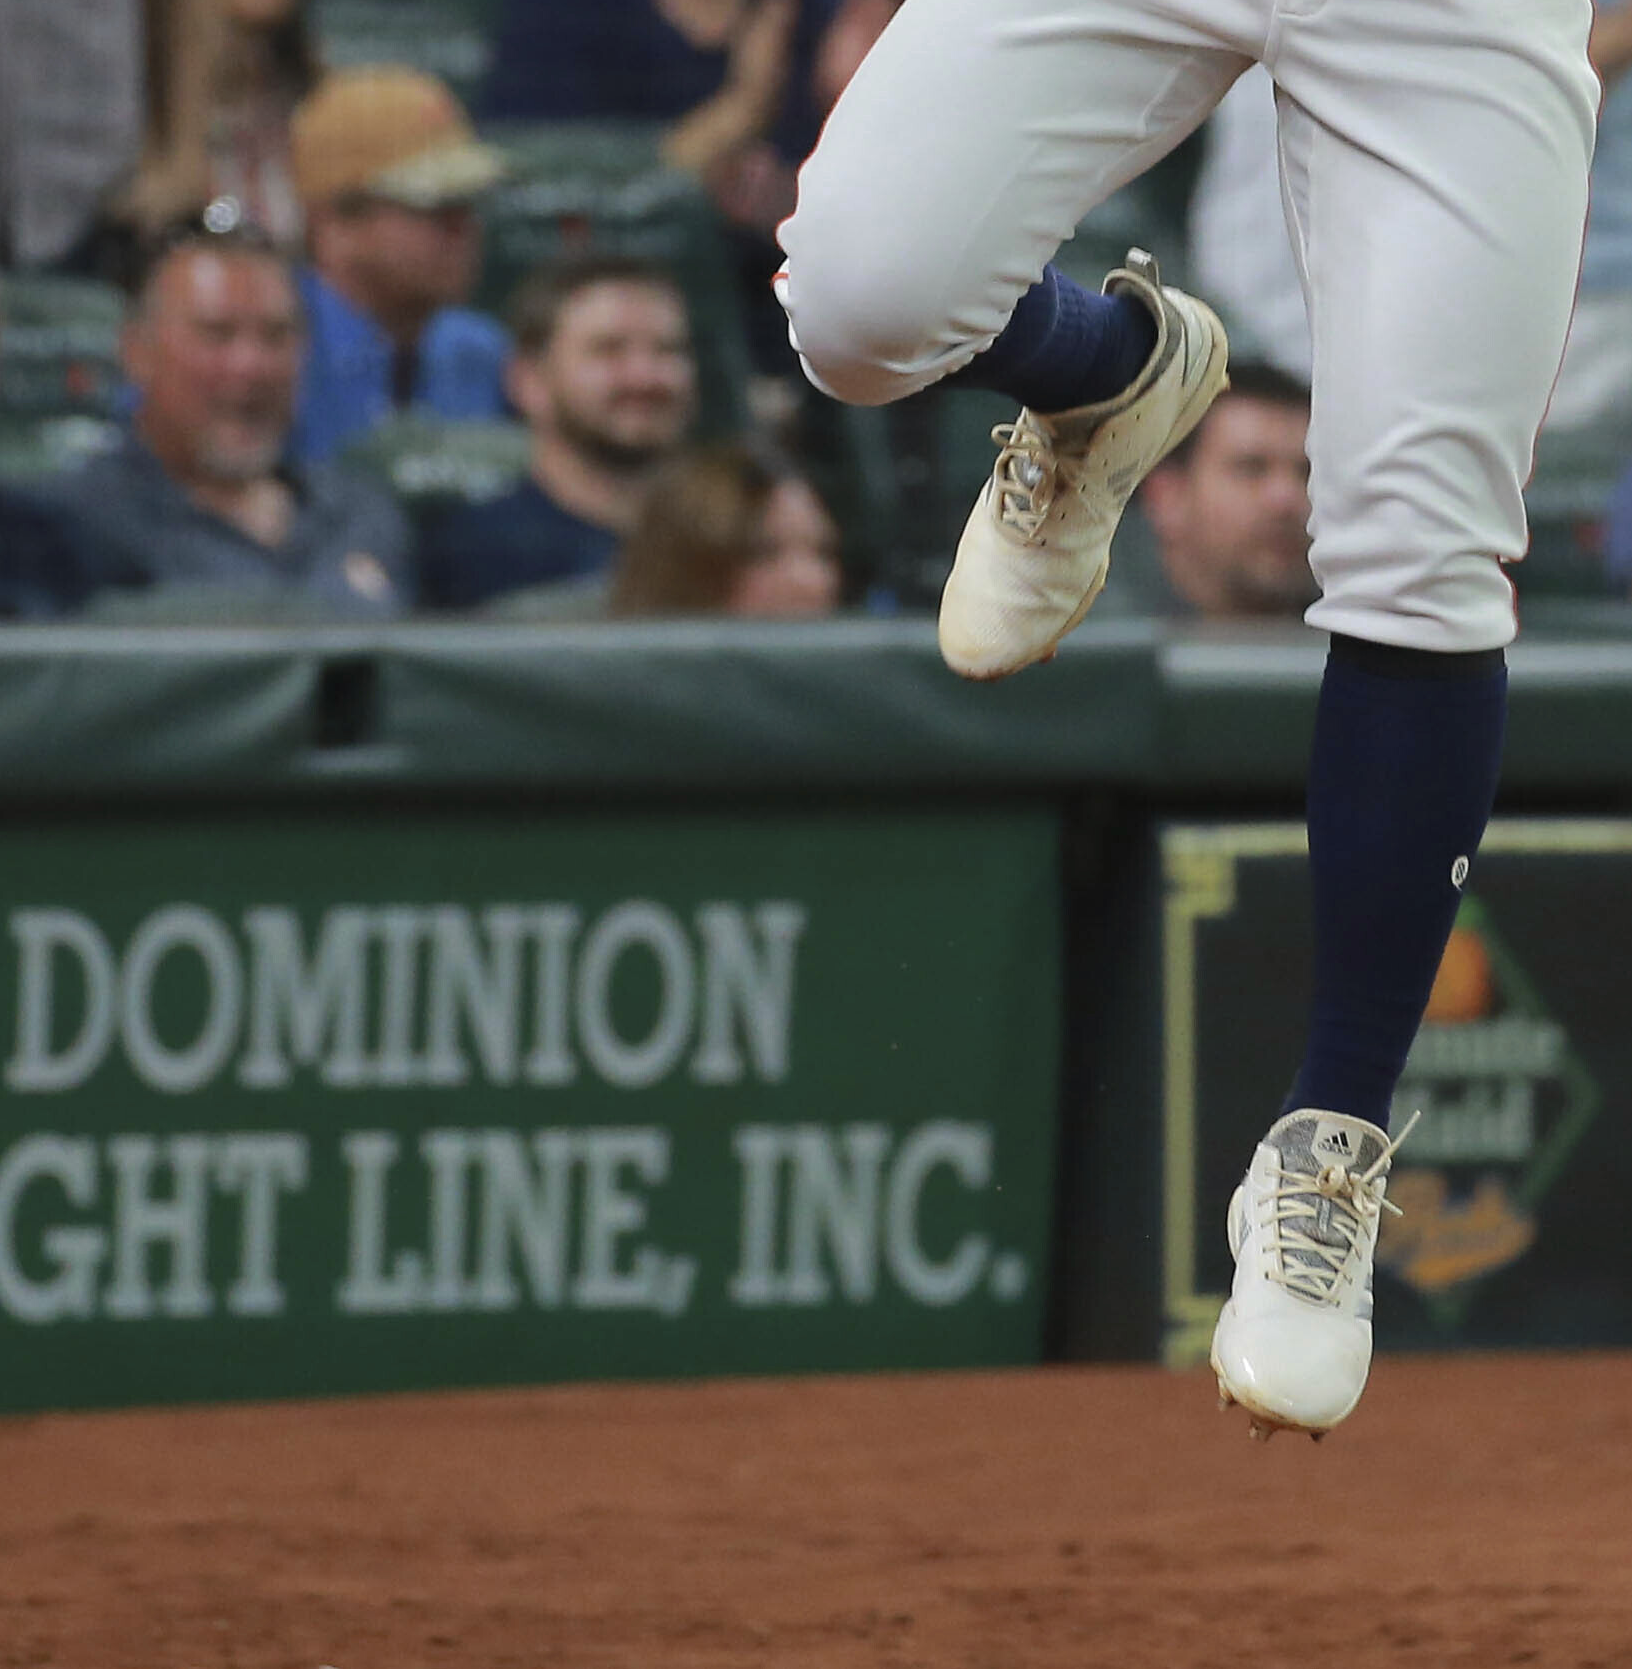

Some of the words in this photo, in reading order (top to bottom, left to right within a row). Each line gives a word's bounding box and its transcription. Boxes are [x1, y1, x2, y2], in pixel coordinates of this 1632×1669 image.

[4, 898, 804, 1093] DOMINION
[337, 1127, 695, 1315] LINE,
[729, 1118, 1027, 1307] INC.
